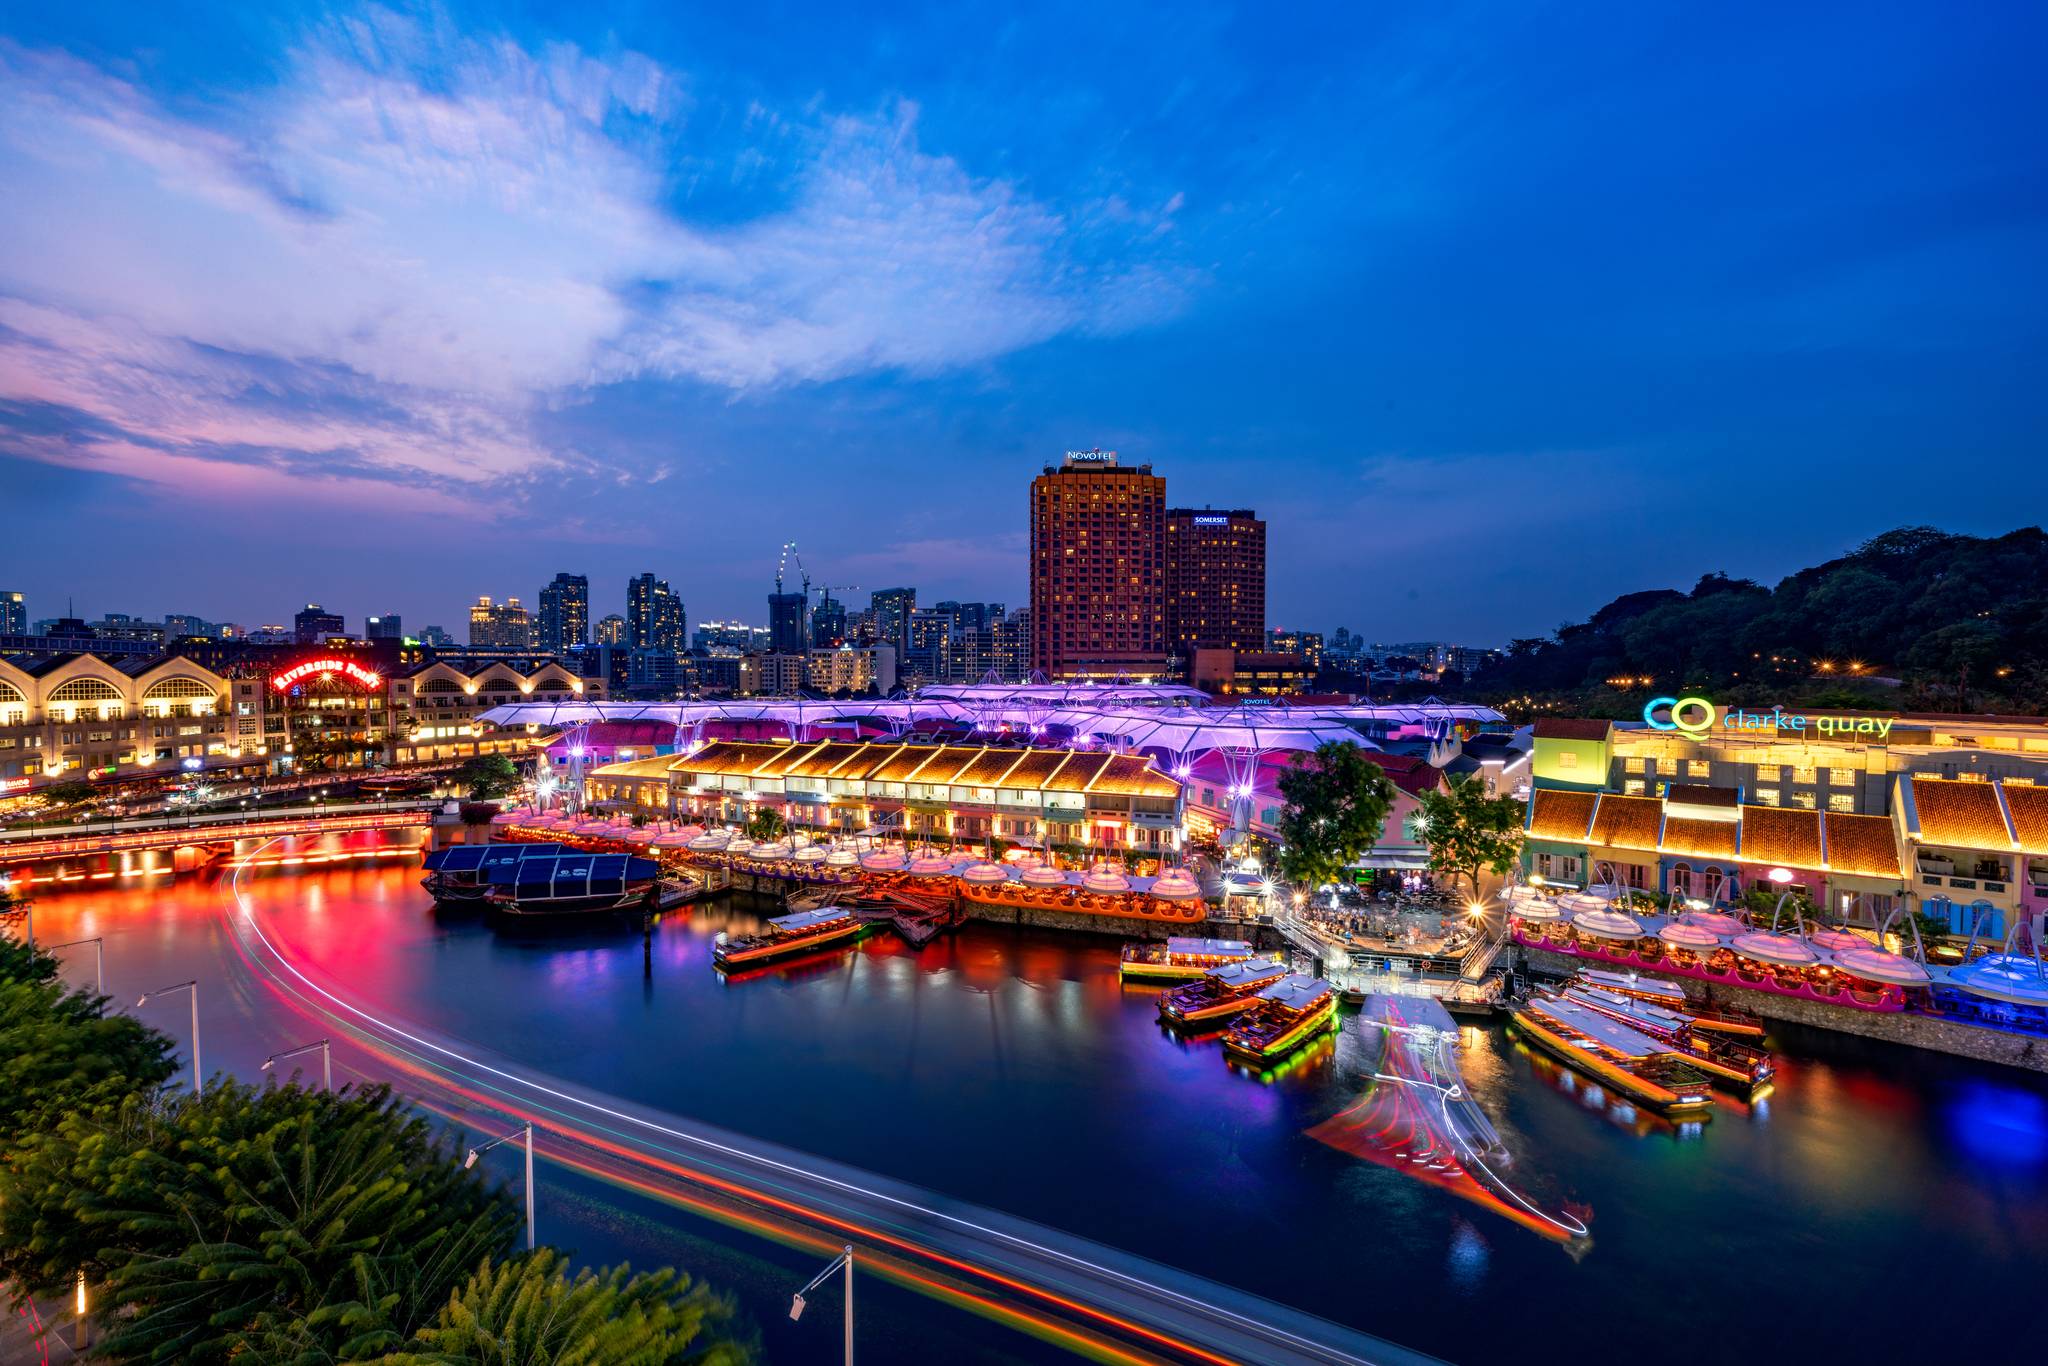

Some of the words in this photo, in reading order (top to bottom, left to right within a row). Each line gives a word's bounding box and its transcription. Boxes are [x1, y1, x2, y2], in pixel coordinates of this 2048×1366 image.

[1067, 451, 1114, 460] NOVOTEL
[273, 660, 344, 690] RIVERSIDE
[1723, 709, 1807, 730] clarke
[1816, 716, 1894, 738] quay
